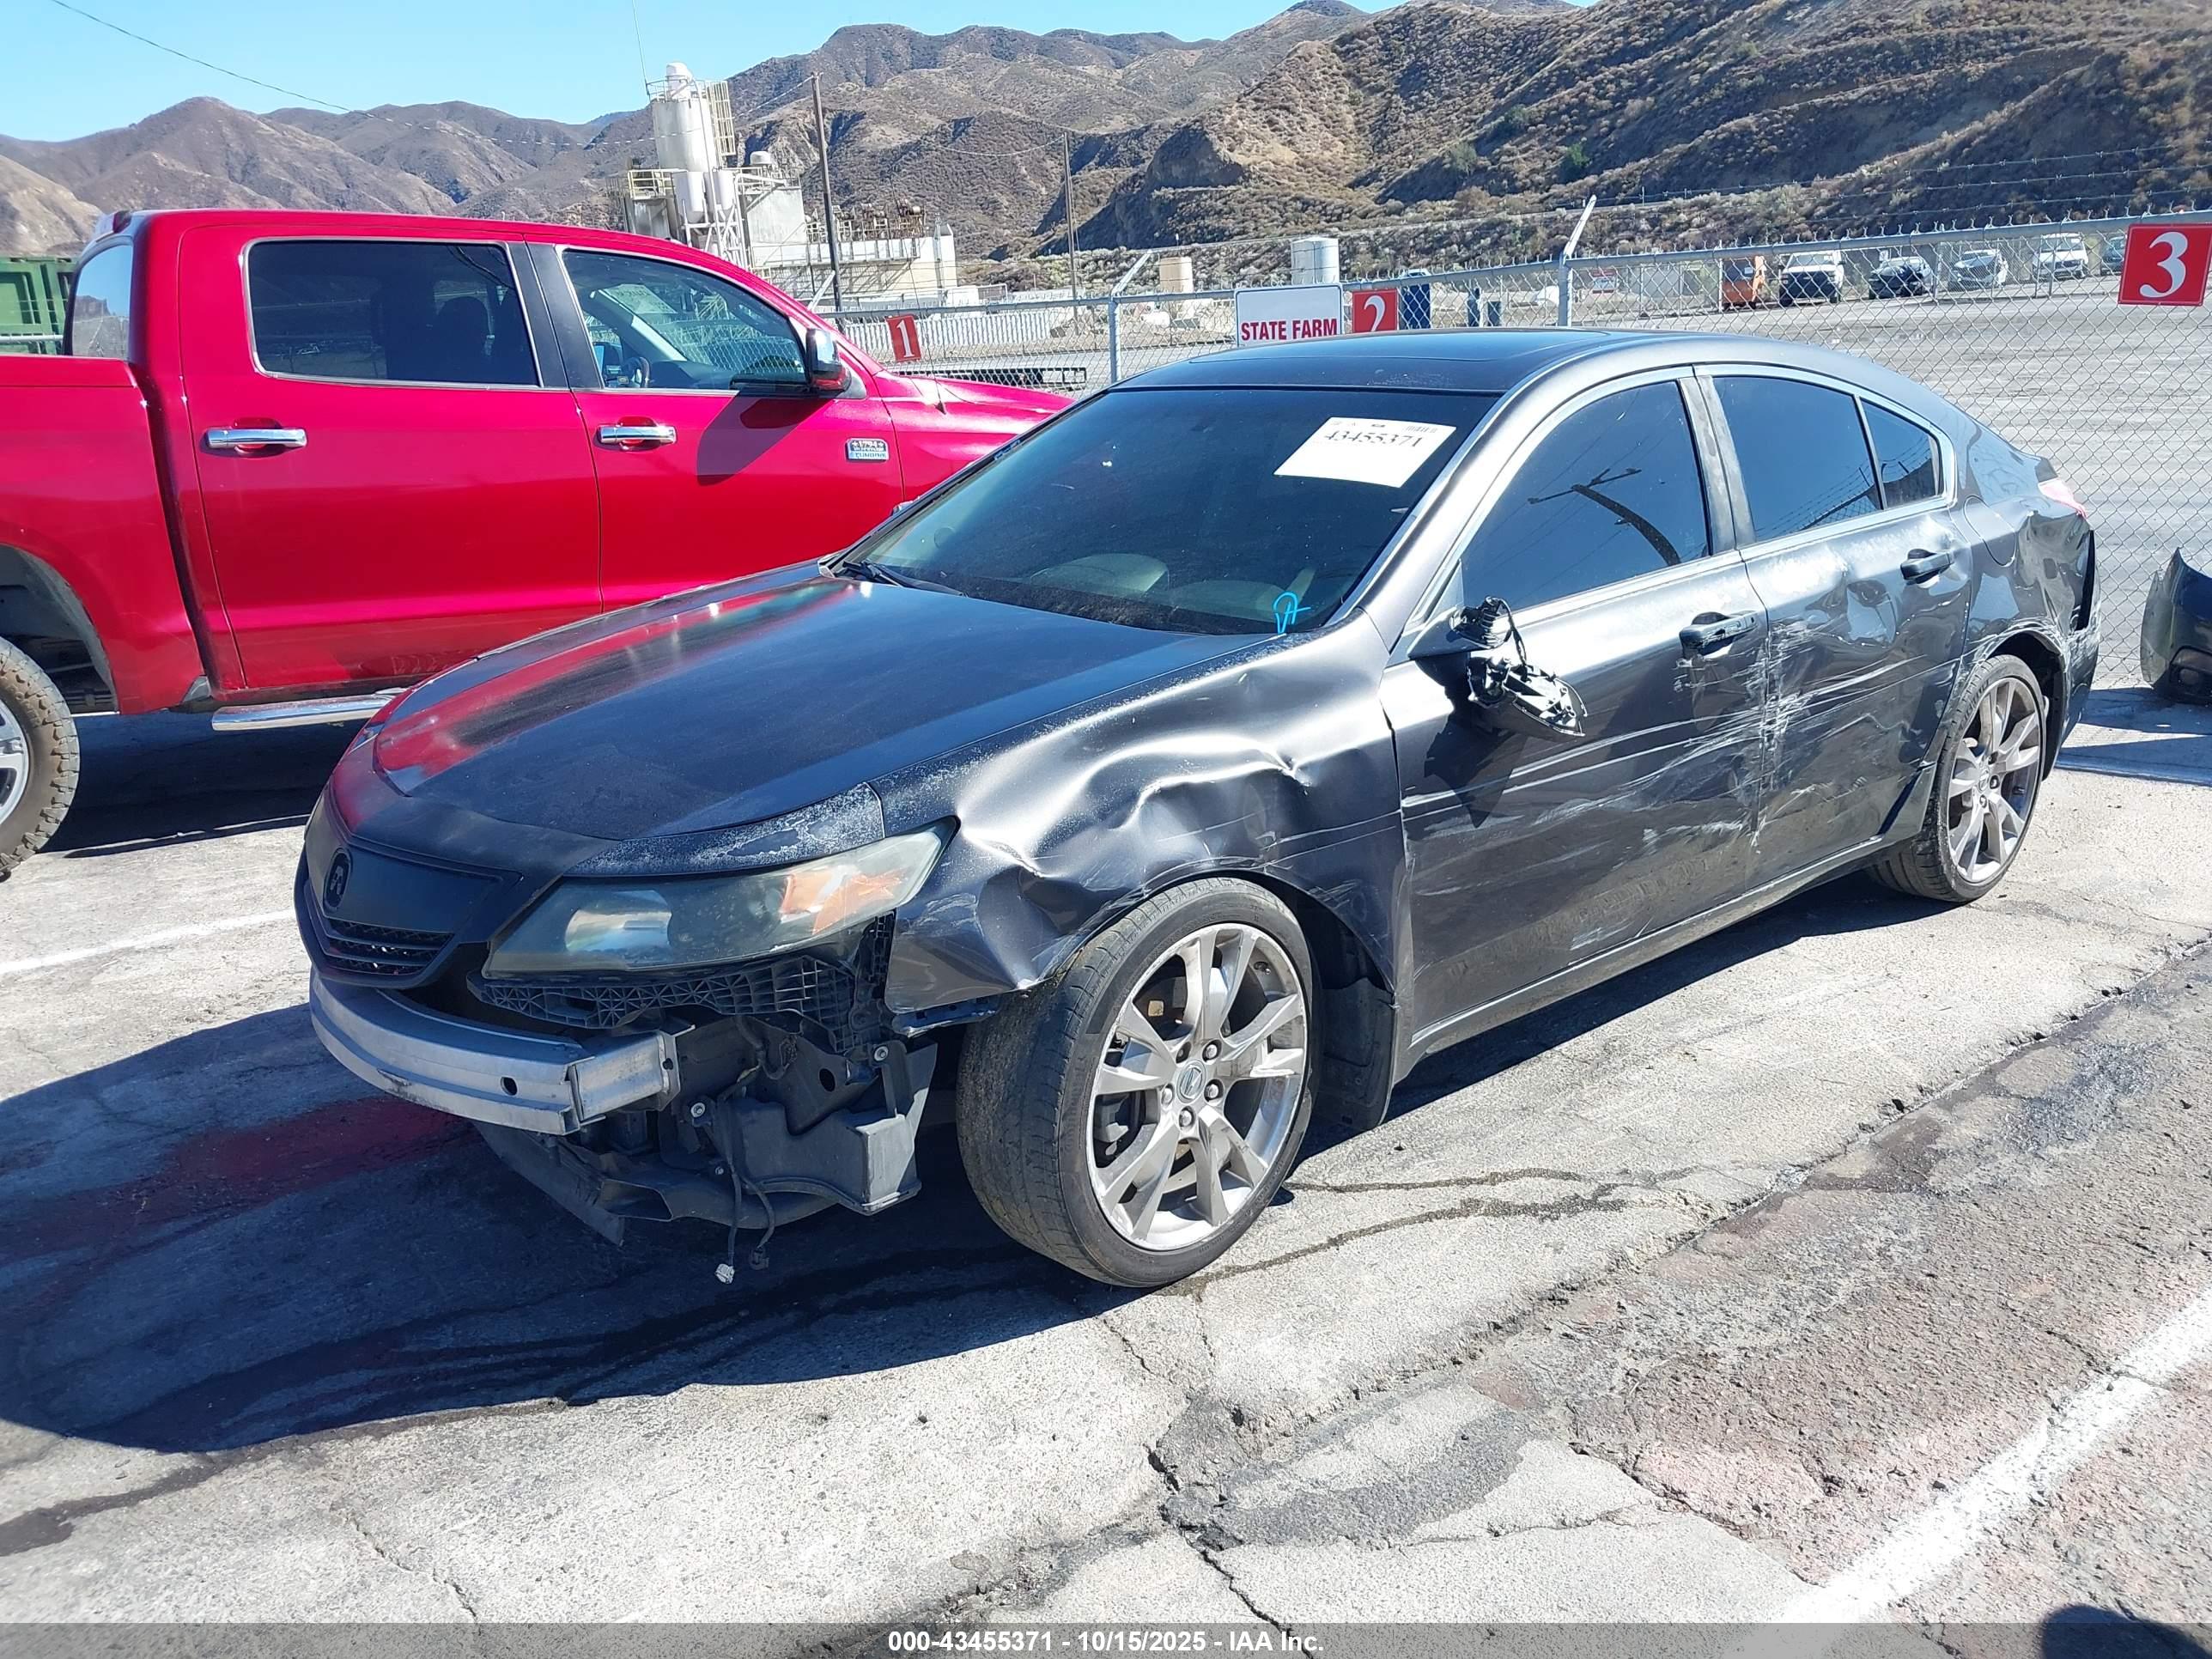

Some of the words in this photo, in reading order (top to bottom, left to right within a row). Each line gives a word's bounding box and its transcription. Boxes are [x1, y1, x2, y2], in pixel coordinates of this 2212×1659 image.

[2139, 231, 2188, 298] 3
[1241, 320, 1287, 342] STATE
[1292, 318, 1338, 339] FARM
[1363, 295, 1386, 332] 2
[896, 319, 915, 358] 1
[1324, 430, 1423, 447] 43455371
